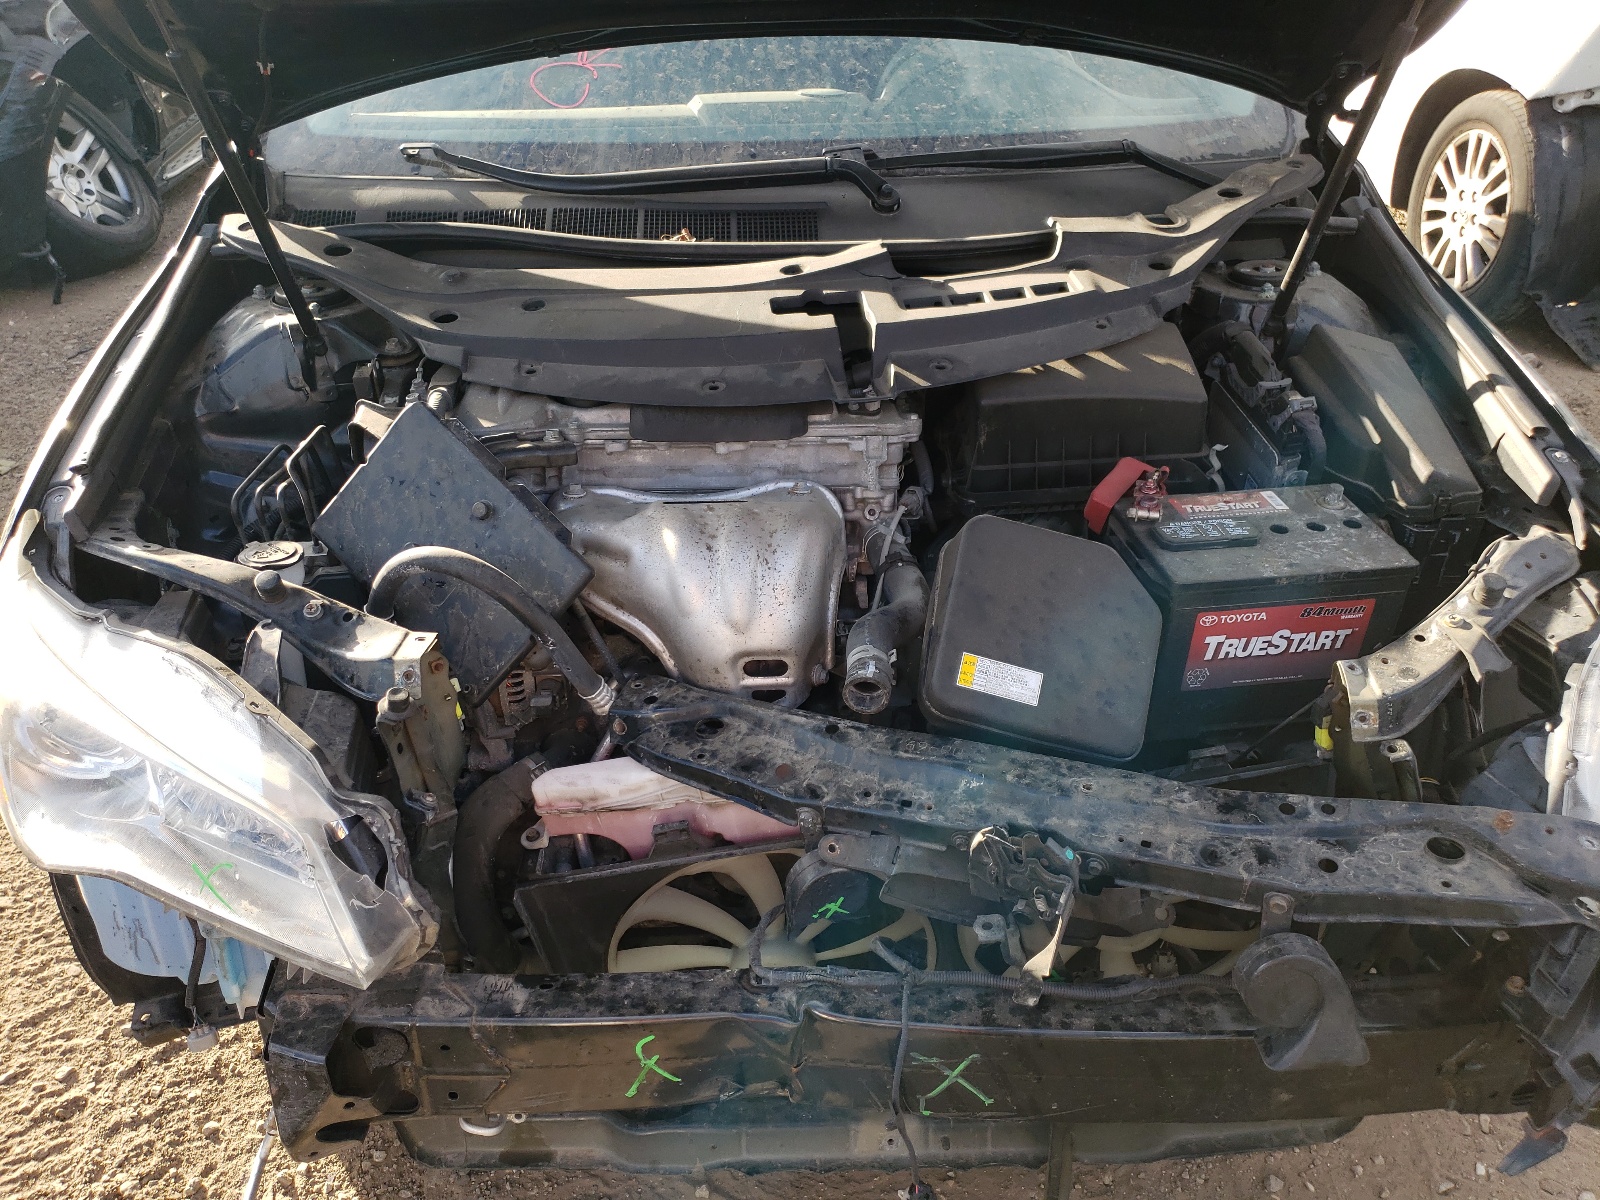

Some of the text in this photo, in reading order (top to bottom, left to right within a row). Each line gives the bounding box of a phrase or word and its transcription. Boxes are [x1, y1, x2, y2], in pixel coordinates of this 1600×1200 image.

[1182, 501, 1261, 513] TRUESTART
[1220, 611, 1267, 624] TOYOTA
[1203, 629, 1353, 661] TRUESTART
